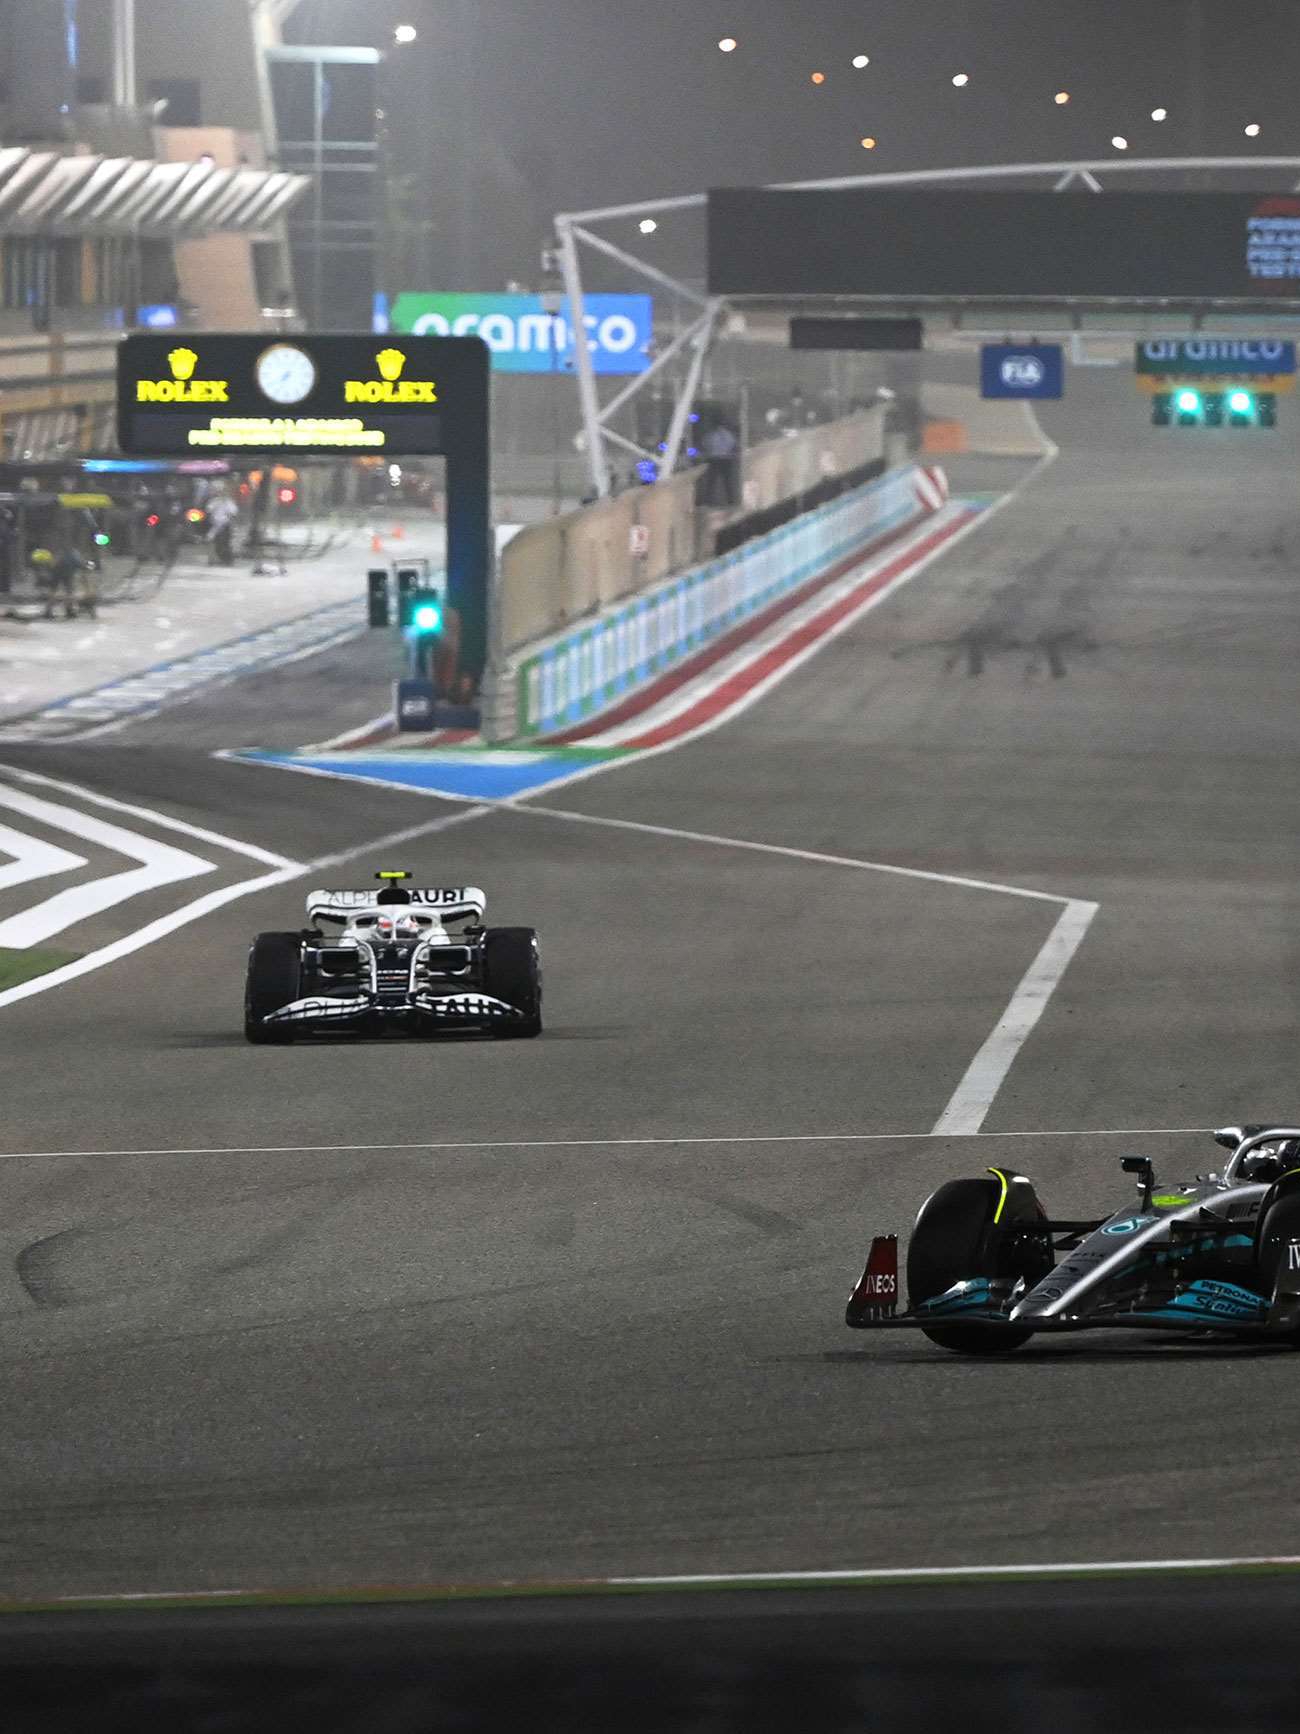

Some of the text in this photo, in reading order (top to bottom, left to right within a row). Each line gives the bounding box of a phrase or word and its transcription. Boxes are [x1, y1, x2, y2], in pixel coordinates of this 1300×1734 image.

[1001, 360, 1042, 382] FIA
[136, 380, 229, 402] ROLEX
[344, 380, 438, 402] ROLEX
[865, 1274, 896, 1294] INEOS
